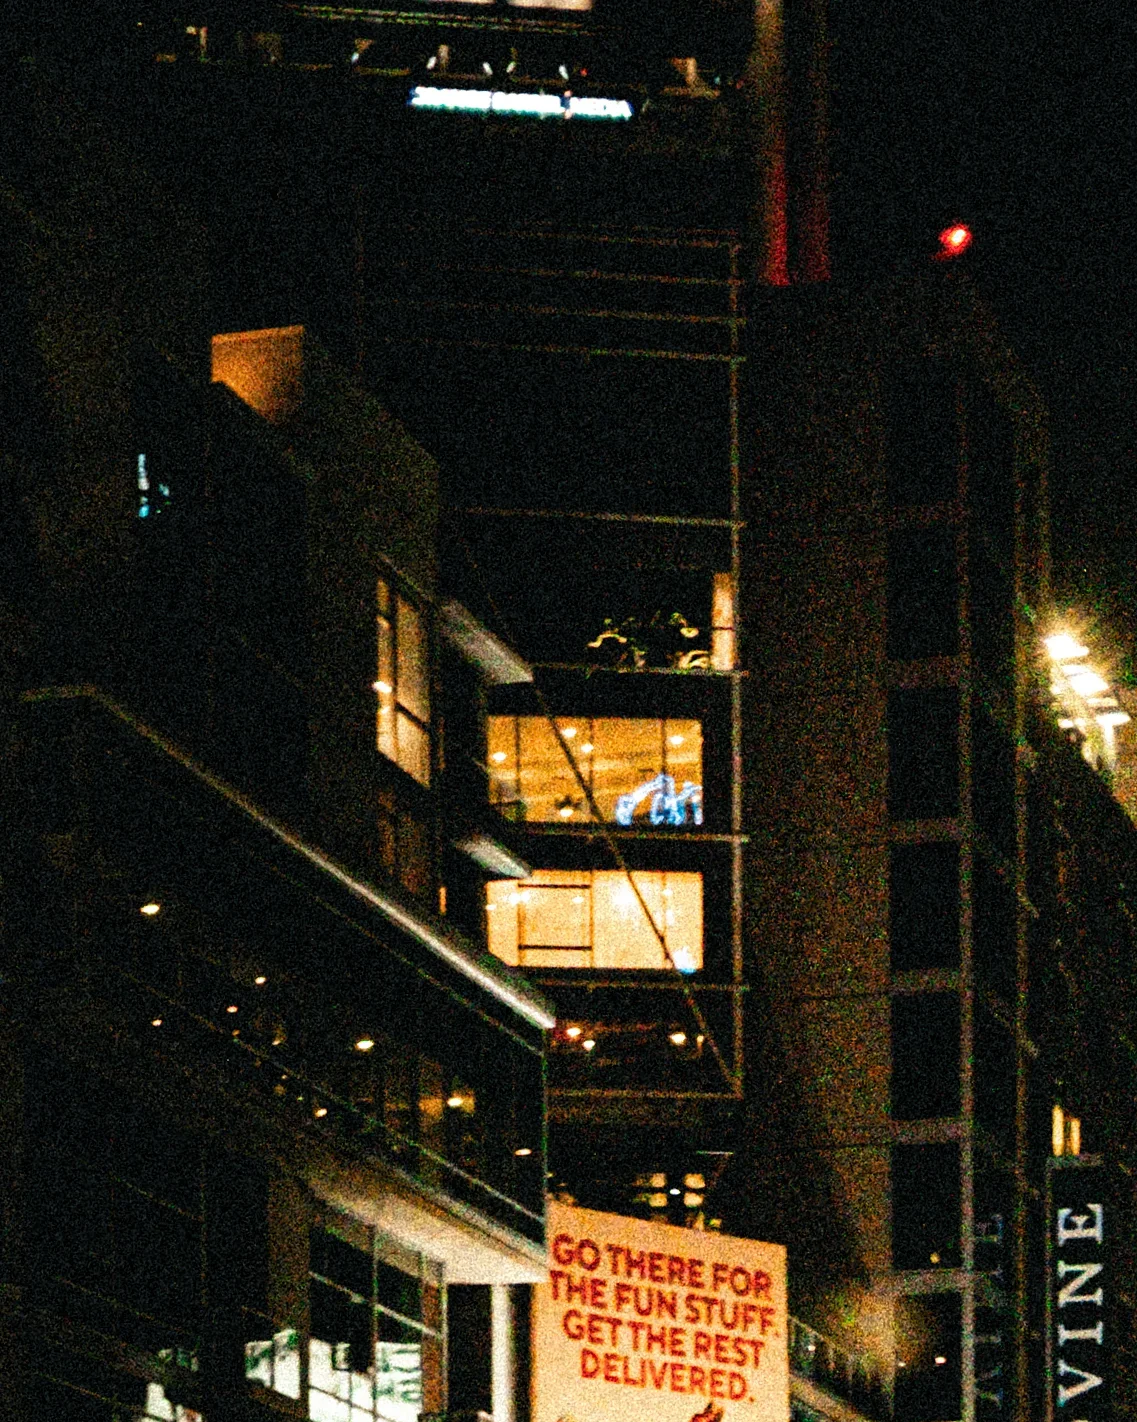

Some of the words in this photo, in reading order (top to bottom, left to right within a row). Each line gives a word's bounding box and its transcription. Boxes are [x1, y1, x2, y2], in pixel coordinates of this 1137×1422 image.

[549, 1269, 608, 1310] THE
[614, 1282, 678, 1319] FUN
[551, 1232, 602, 1272] GO
[604, 1243, 706, 1290] THERE
[711, 1262, 773, 1301] FOR
[1057, 1202, 1105, 1410] VINE
[562, 1308, 624, 1348] GET
[625, 1319, 687, 1358] THE
[693, 1330, 765, 1370] REST
[580, 1347, 757, 1405] DELIVERED.
